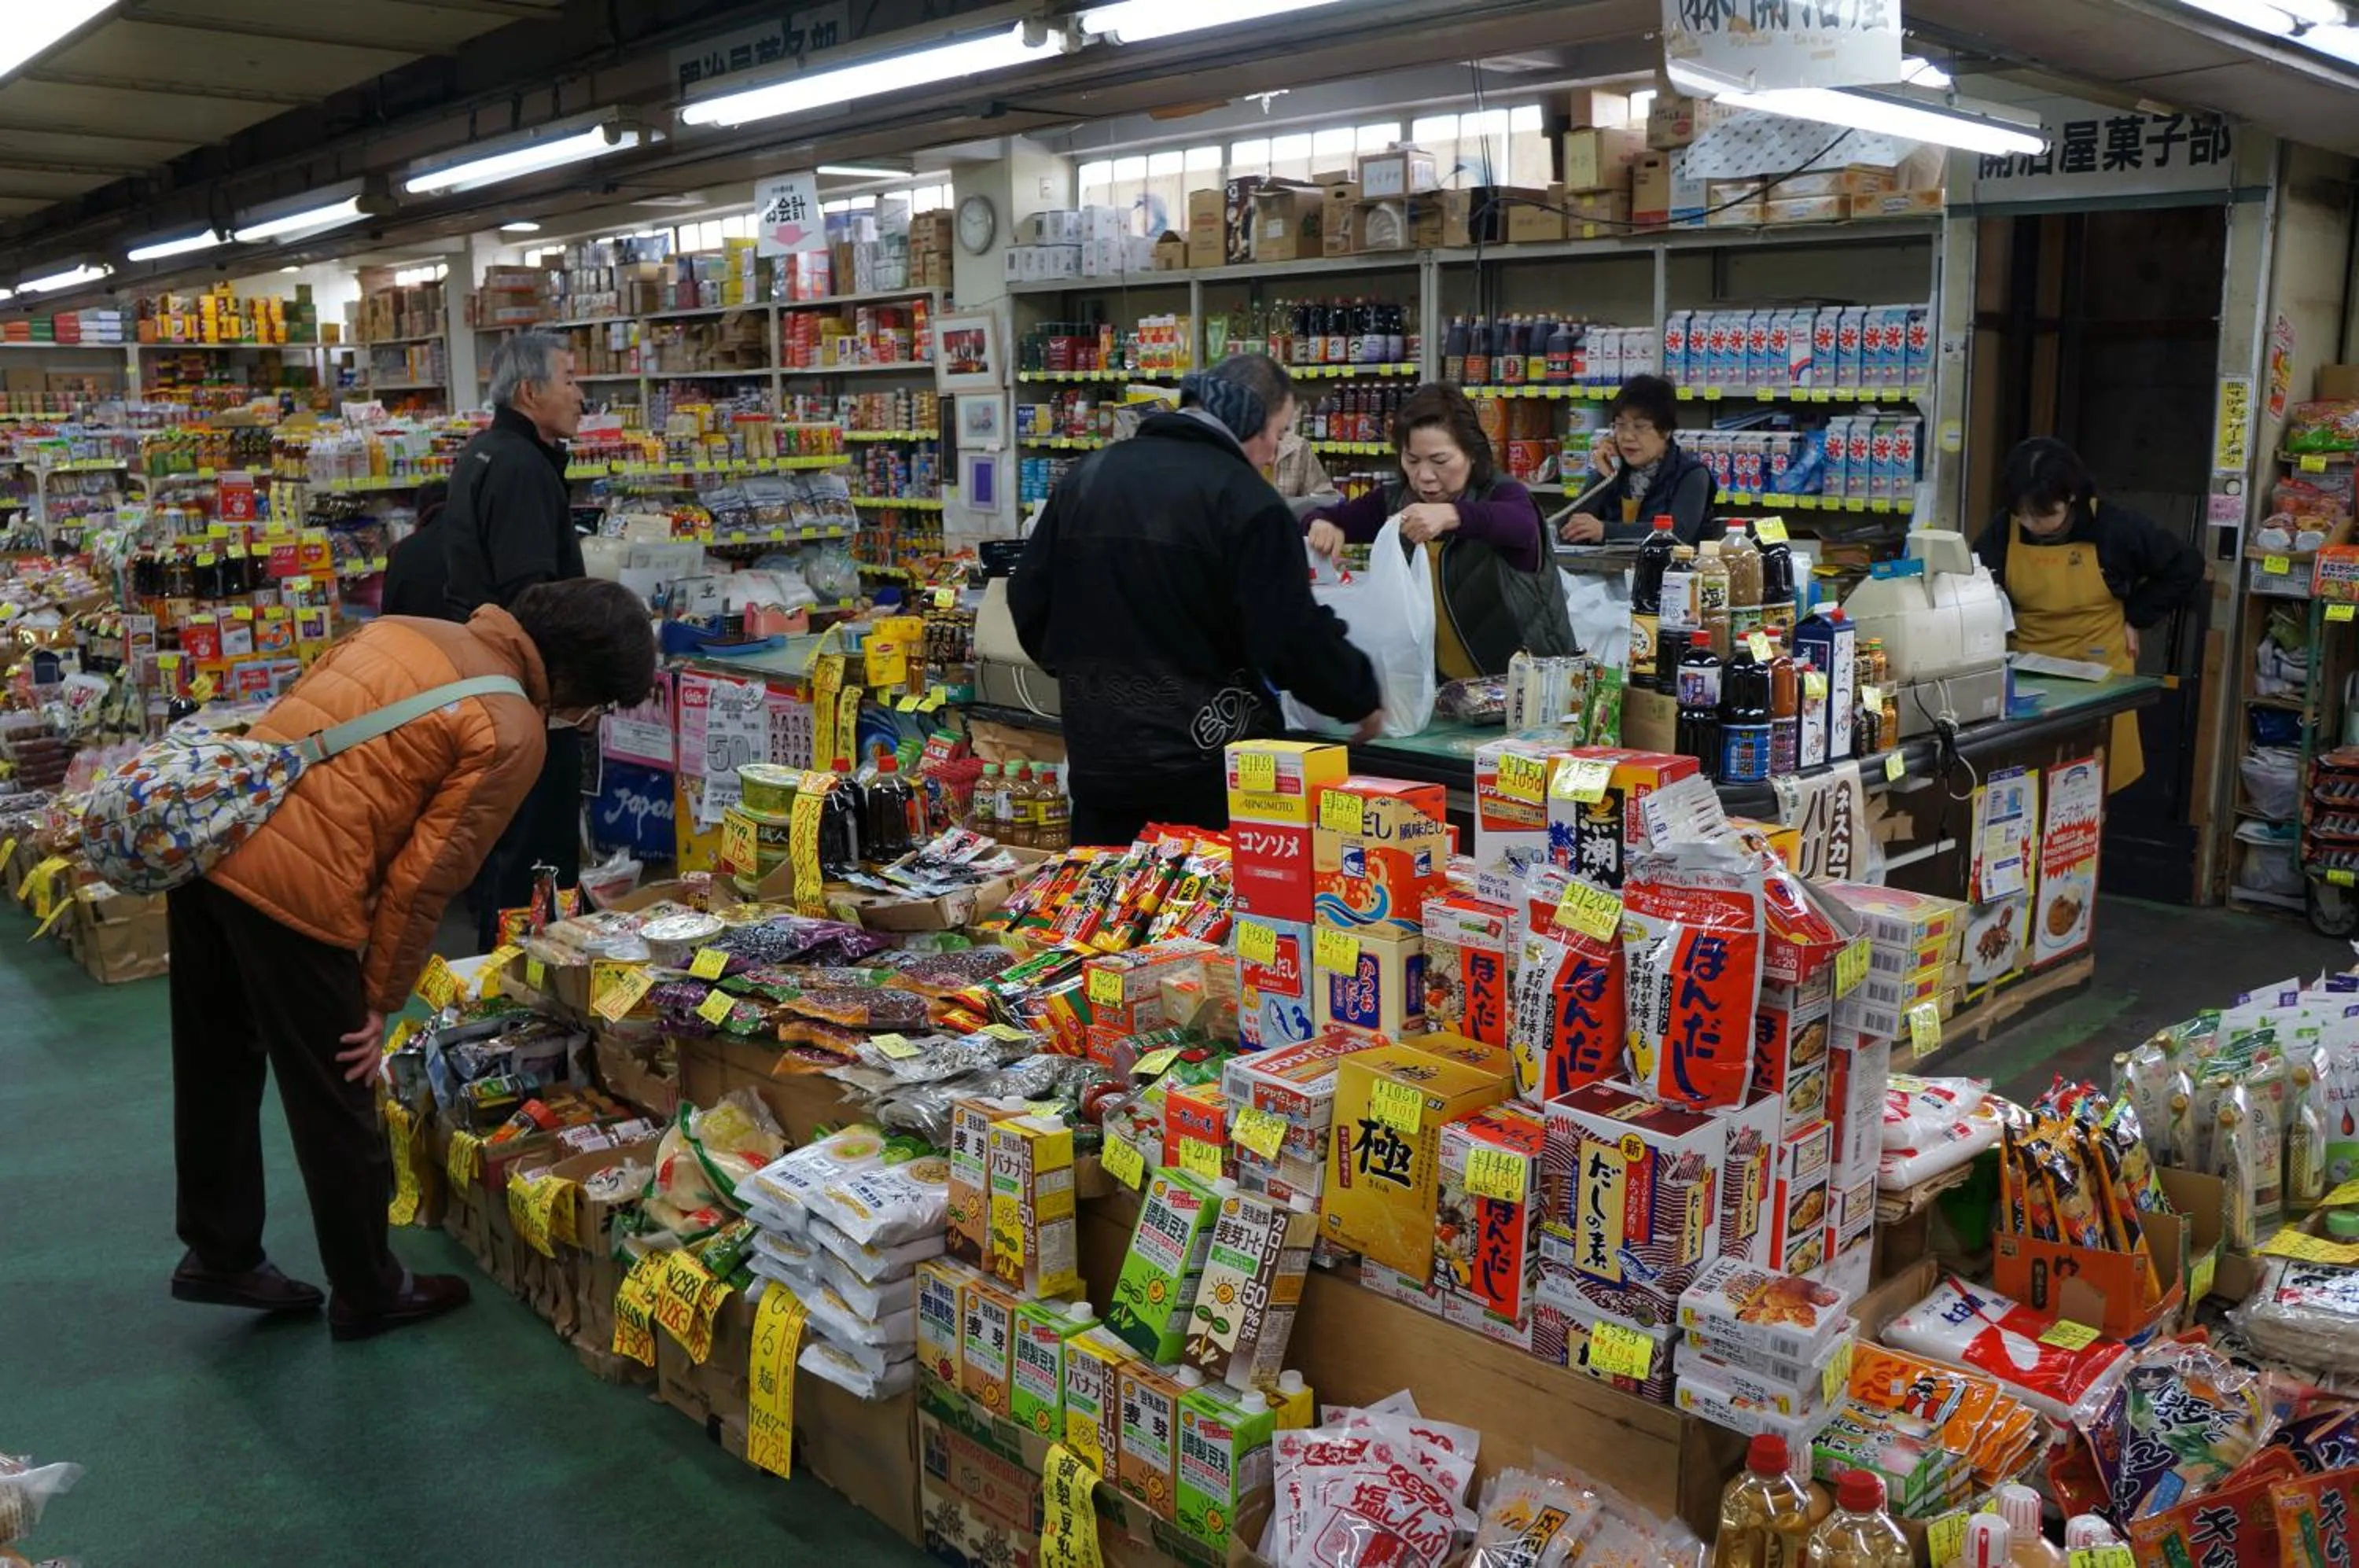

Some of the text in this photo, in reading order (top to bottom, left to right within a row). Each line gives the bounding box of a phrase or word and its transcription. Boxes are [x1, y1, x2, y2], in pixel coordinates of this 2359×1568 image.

[1238, 831, 1300, 858] コンソメ
[1399, 818, 1445, 841] 風味だし
[1470, 951, 1497, 1042] ほんだし
[1556, 958, 1610, 1095] ほんだし
[1673, 932, 1728, 1102] ほんだし
[991, 1152, 1021, 1178] バナナ
[1351, 1101, 1414, 1189] 極
[1472, 1149, 1522, 1176] ¥1449
[1623, 1139, 1641, 1158] 新
[1143, 1198, 1191, 1247] 調製豆乳
[1583, 1150, 1622, 1271] だしの素
[1483, 1198, 1515, 1302] ほんだし
[1067, 1370, 1102, 1401] バナナ
[1350, 1482, 1450, 1561] 塩こんぶ
